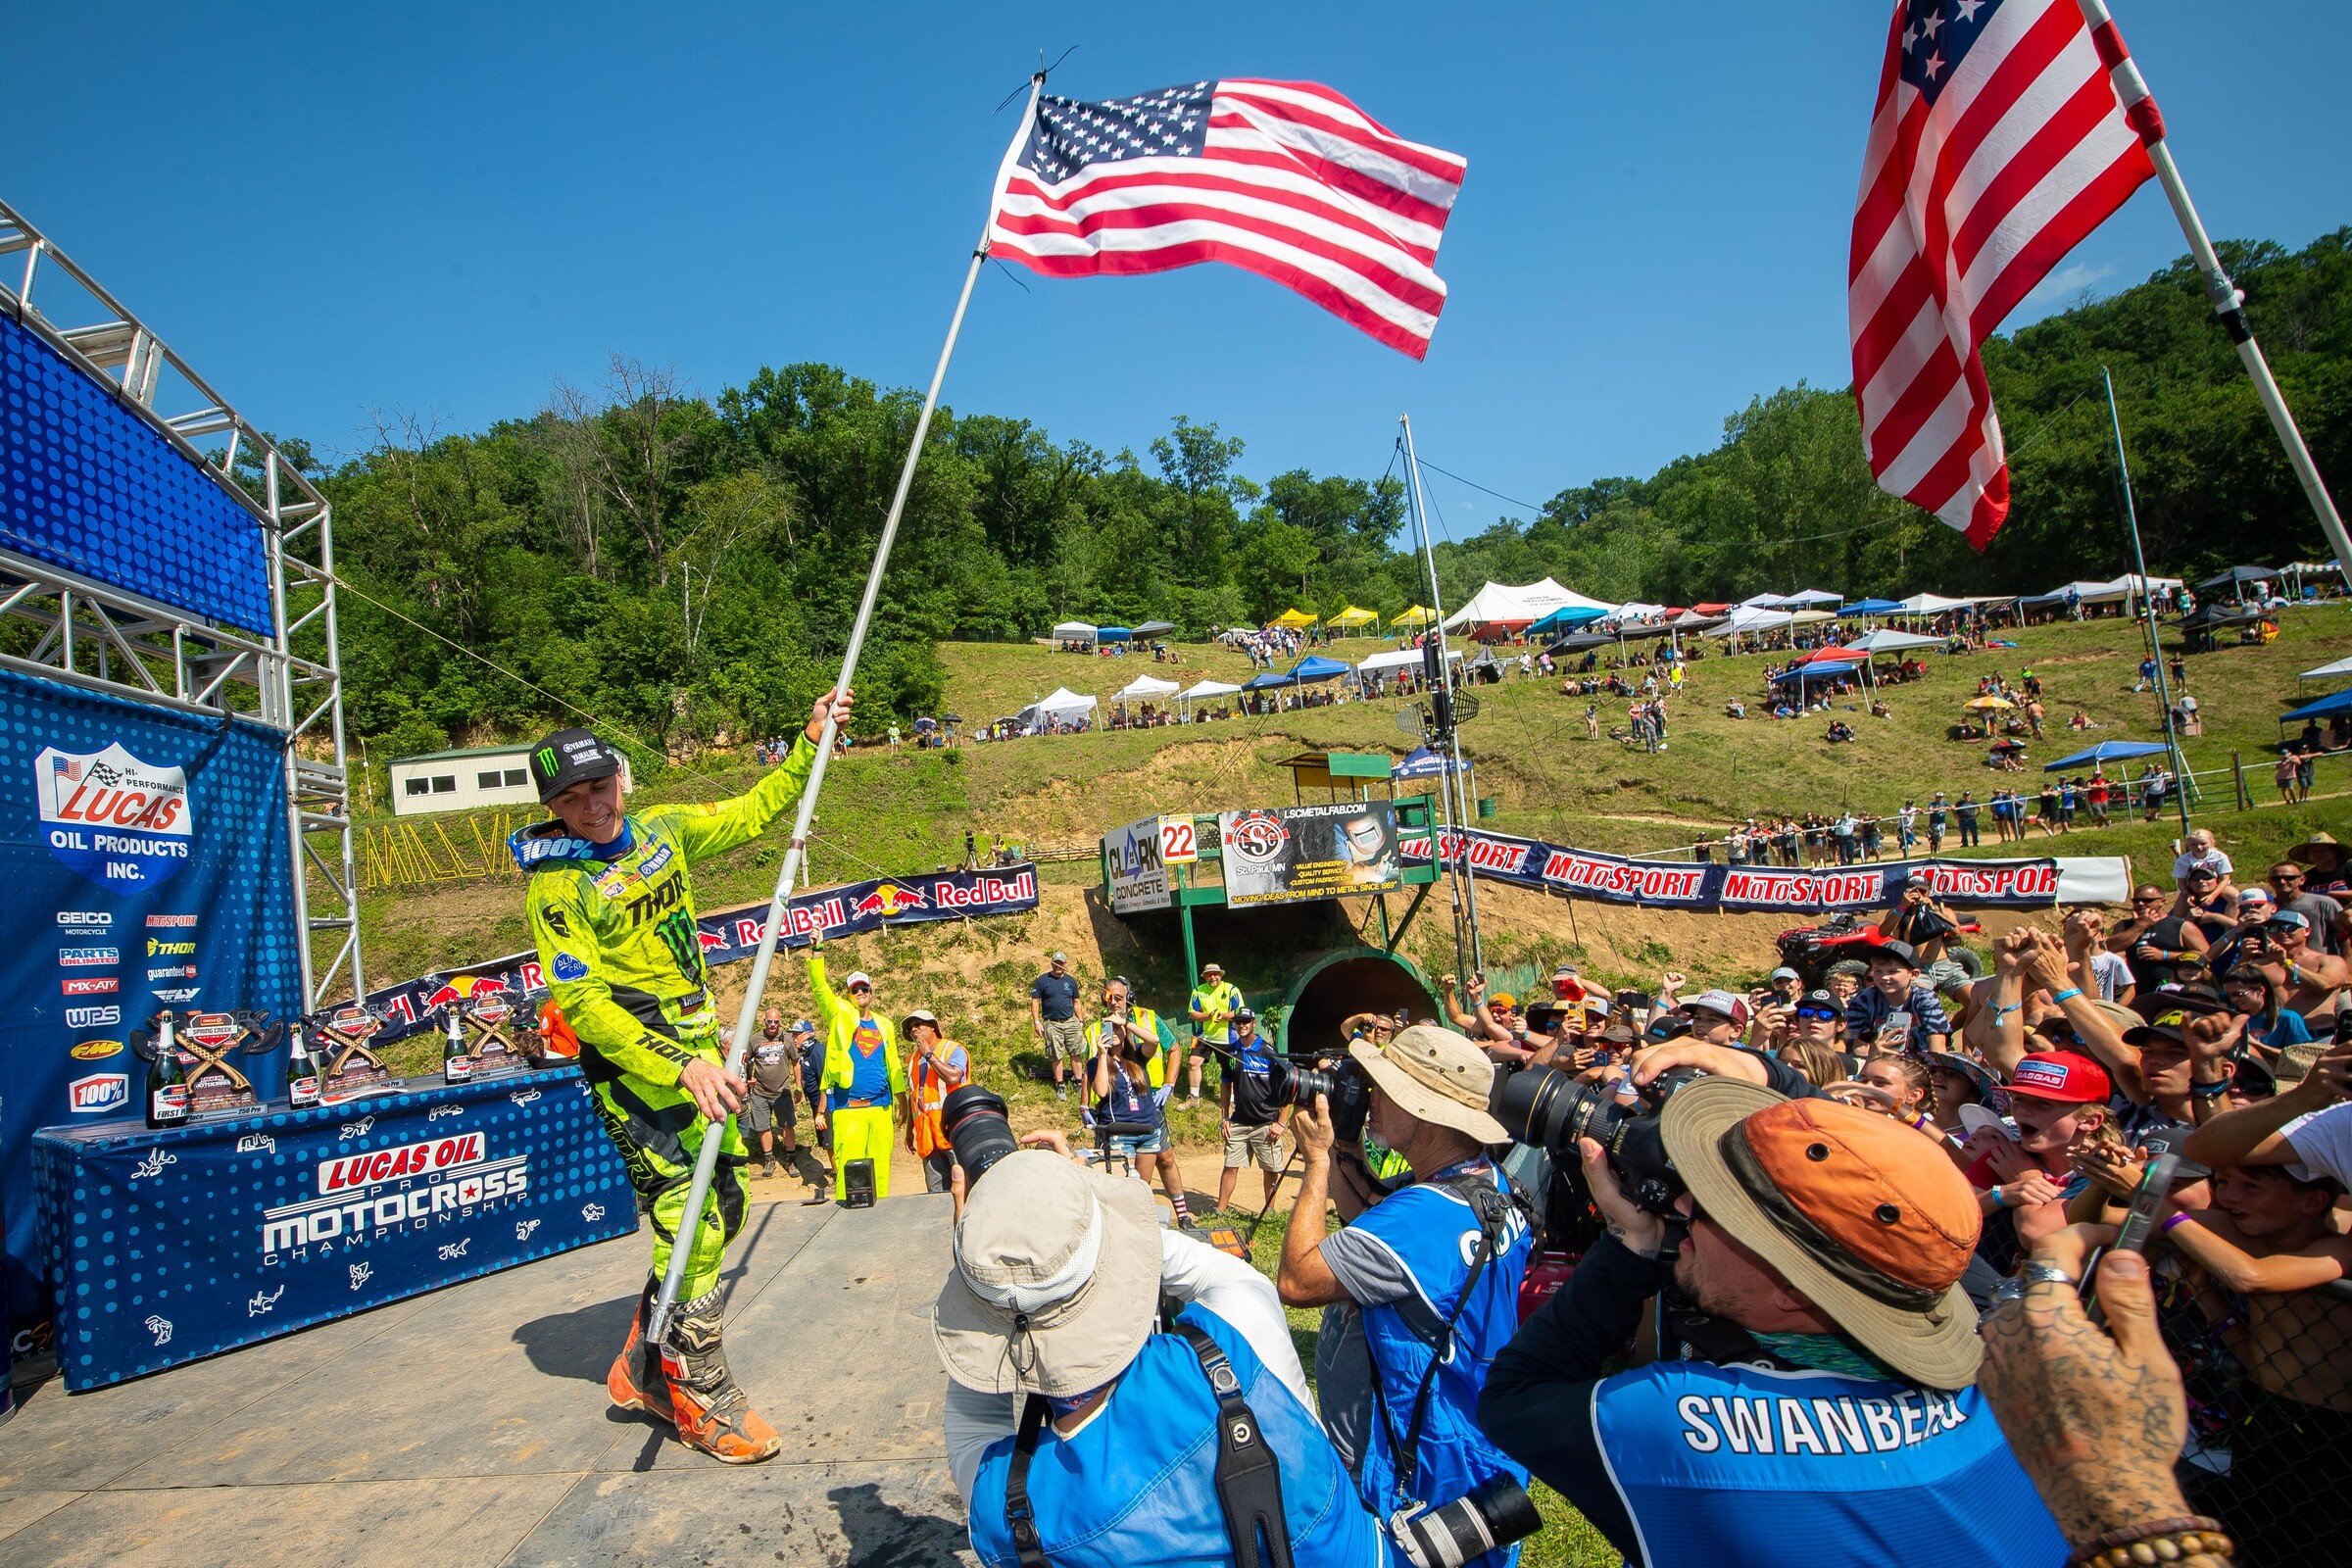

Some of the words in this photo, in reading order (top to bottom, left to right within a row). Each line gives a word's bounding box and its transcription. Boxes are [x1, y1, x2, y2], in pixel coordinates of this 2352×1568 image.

[124, 767, 138, 776] HI-
[126, 779, 184, 795] PERFORMANCE
[59, 785, 182, 830] LUCAS
[1284, 804, 1367, 819] LSCMETALFAB.COM
[50, 831, 88, 851] OIL
[94, 834, 188, 858] PRODUCTS
[1162, 824, 1196, 858] 22
[520, 838, 594, 863] 100%
[106, 861, 145, 880] INC.
[1236, 866, 1250, 875] St.
[1250, 864, 1270, 874] Paul,
[1272, 863, 1286, 872] MN
[935, 879, 985, 908] Red
[986, 871, 1035, 904] Bull
[1115, 878, 1164, 900] CONCRETE
[1286, 889, 1306, 899] FROM
[1307, 888, 1324, 897] MIND
[1337, 885, 1359, 894] METAL
[1359, 884, 1380, 893] SINCE
[625, 869, 688, 928] THOR
[56, 911, 113, 924] GEICO
[60, 948, 119, 958] PARTS
[158, 942, 196, 955] THOR
[147, 966, 185, 982] guaranteed
[68, 980, 118, 993] MX-ATV
[151, 987, 202, 1001] FLY
[66, 1004, 121, 1028] WPS
[71, 1042, 123, 1057] FMF
[2016, 1070, 2062, 1085] GASGAS
[78, 1079, 123, 1106] 100%
[157, 1108, 179, 1118] FIRST
[326, 1144, 430, 1192] LUCAS
[434, 1135, 479, 1168] OIL
[369, 1173, 441, 1198] PRO
[263, 1165, 529, 1254] MOTOCROSS
[264, 1191, 529, 1267] CHAMPIONSHIP
